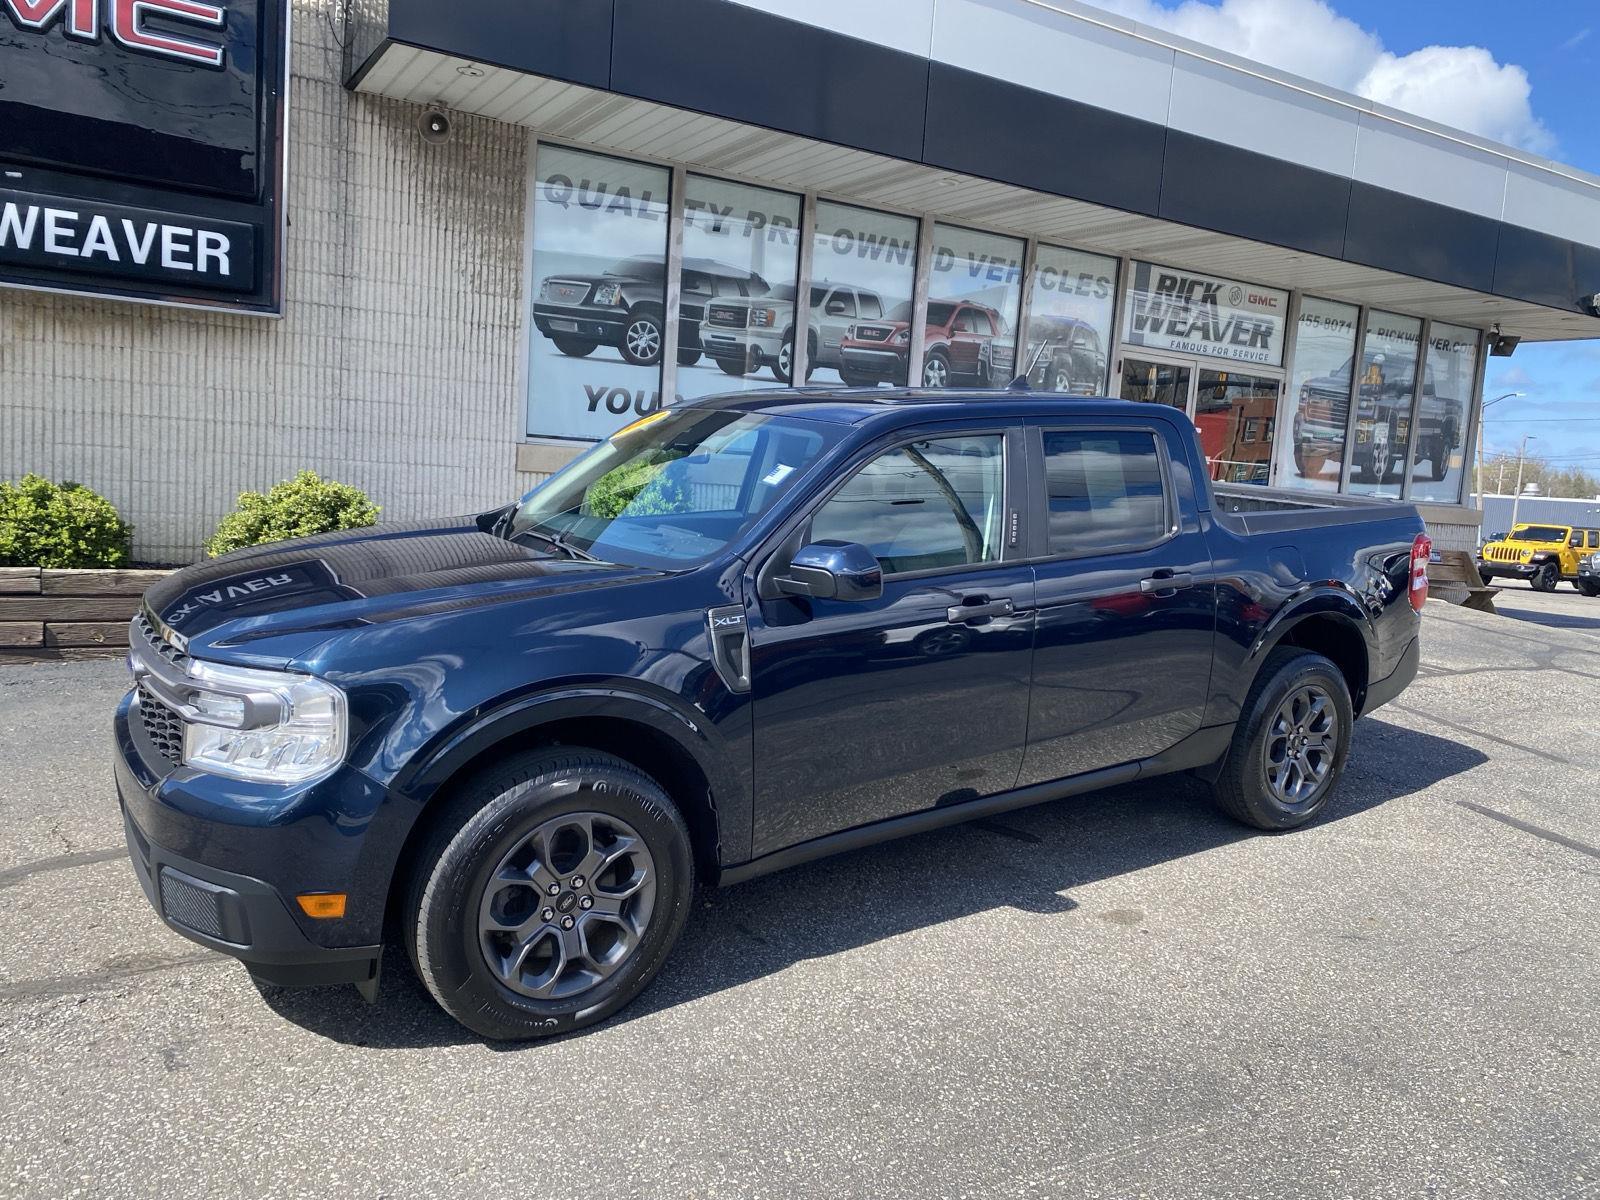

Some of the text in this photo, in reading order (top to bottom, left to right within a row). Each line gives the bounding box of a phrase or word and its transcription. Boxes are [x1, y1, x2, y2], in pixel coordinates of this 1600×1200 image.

[0, 202, 230, 276] WEAVER
[543, 173, 733, 227] QUALTY
[968, 251, 1110, 300] VEHCLES
[1155, 274, 1226, 307] RICK
[1247, 293, 1278, 308] GMC
[1133, 297, 1276, 350] WEAVER
[1170, 340, 1270, 361] FAMOUS FOR SERVICE
[714, 615, 745, 627] XLT
